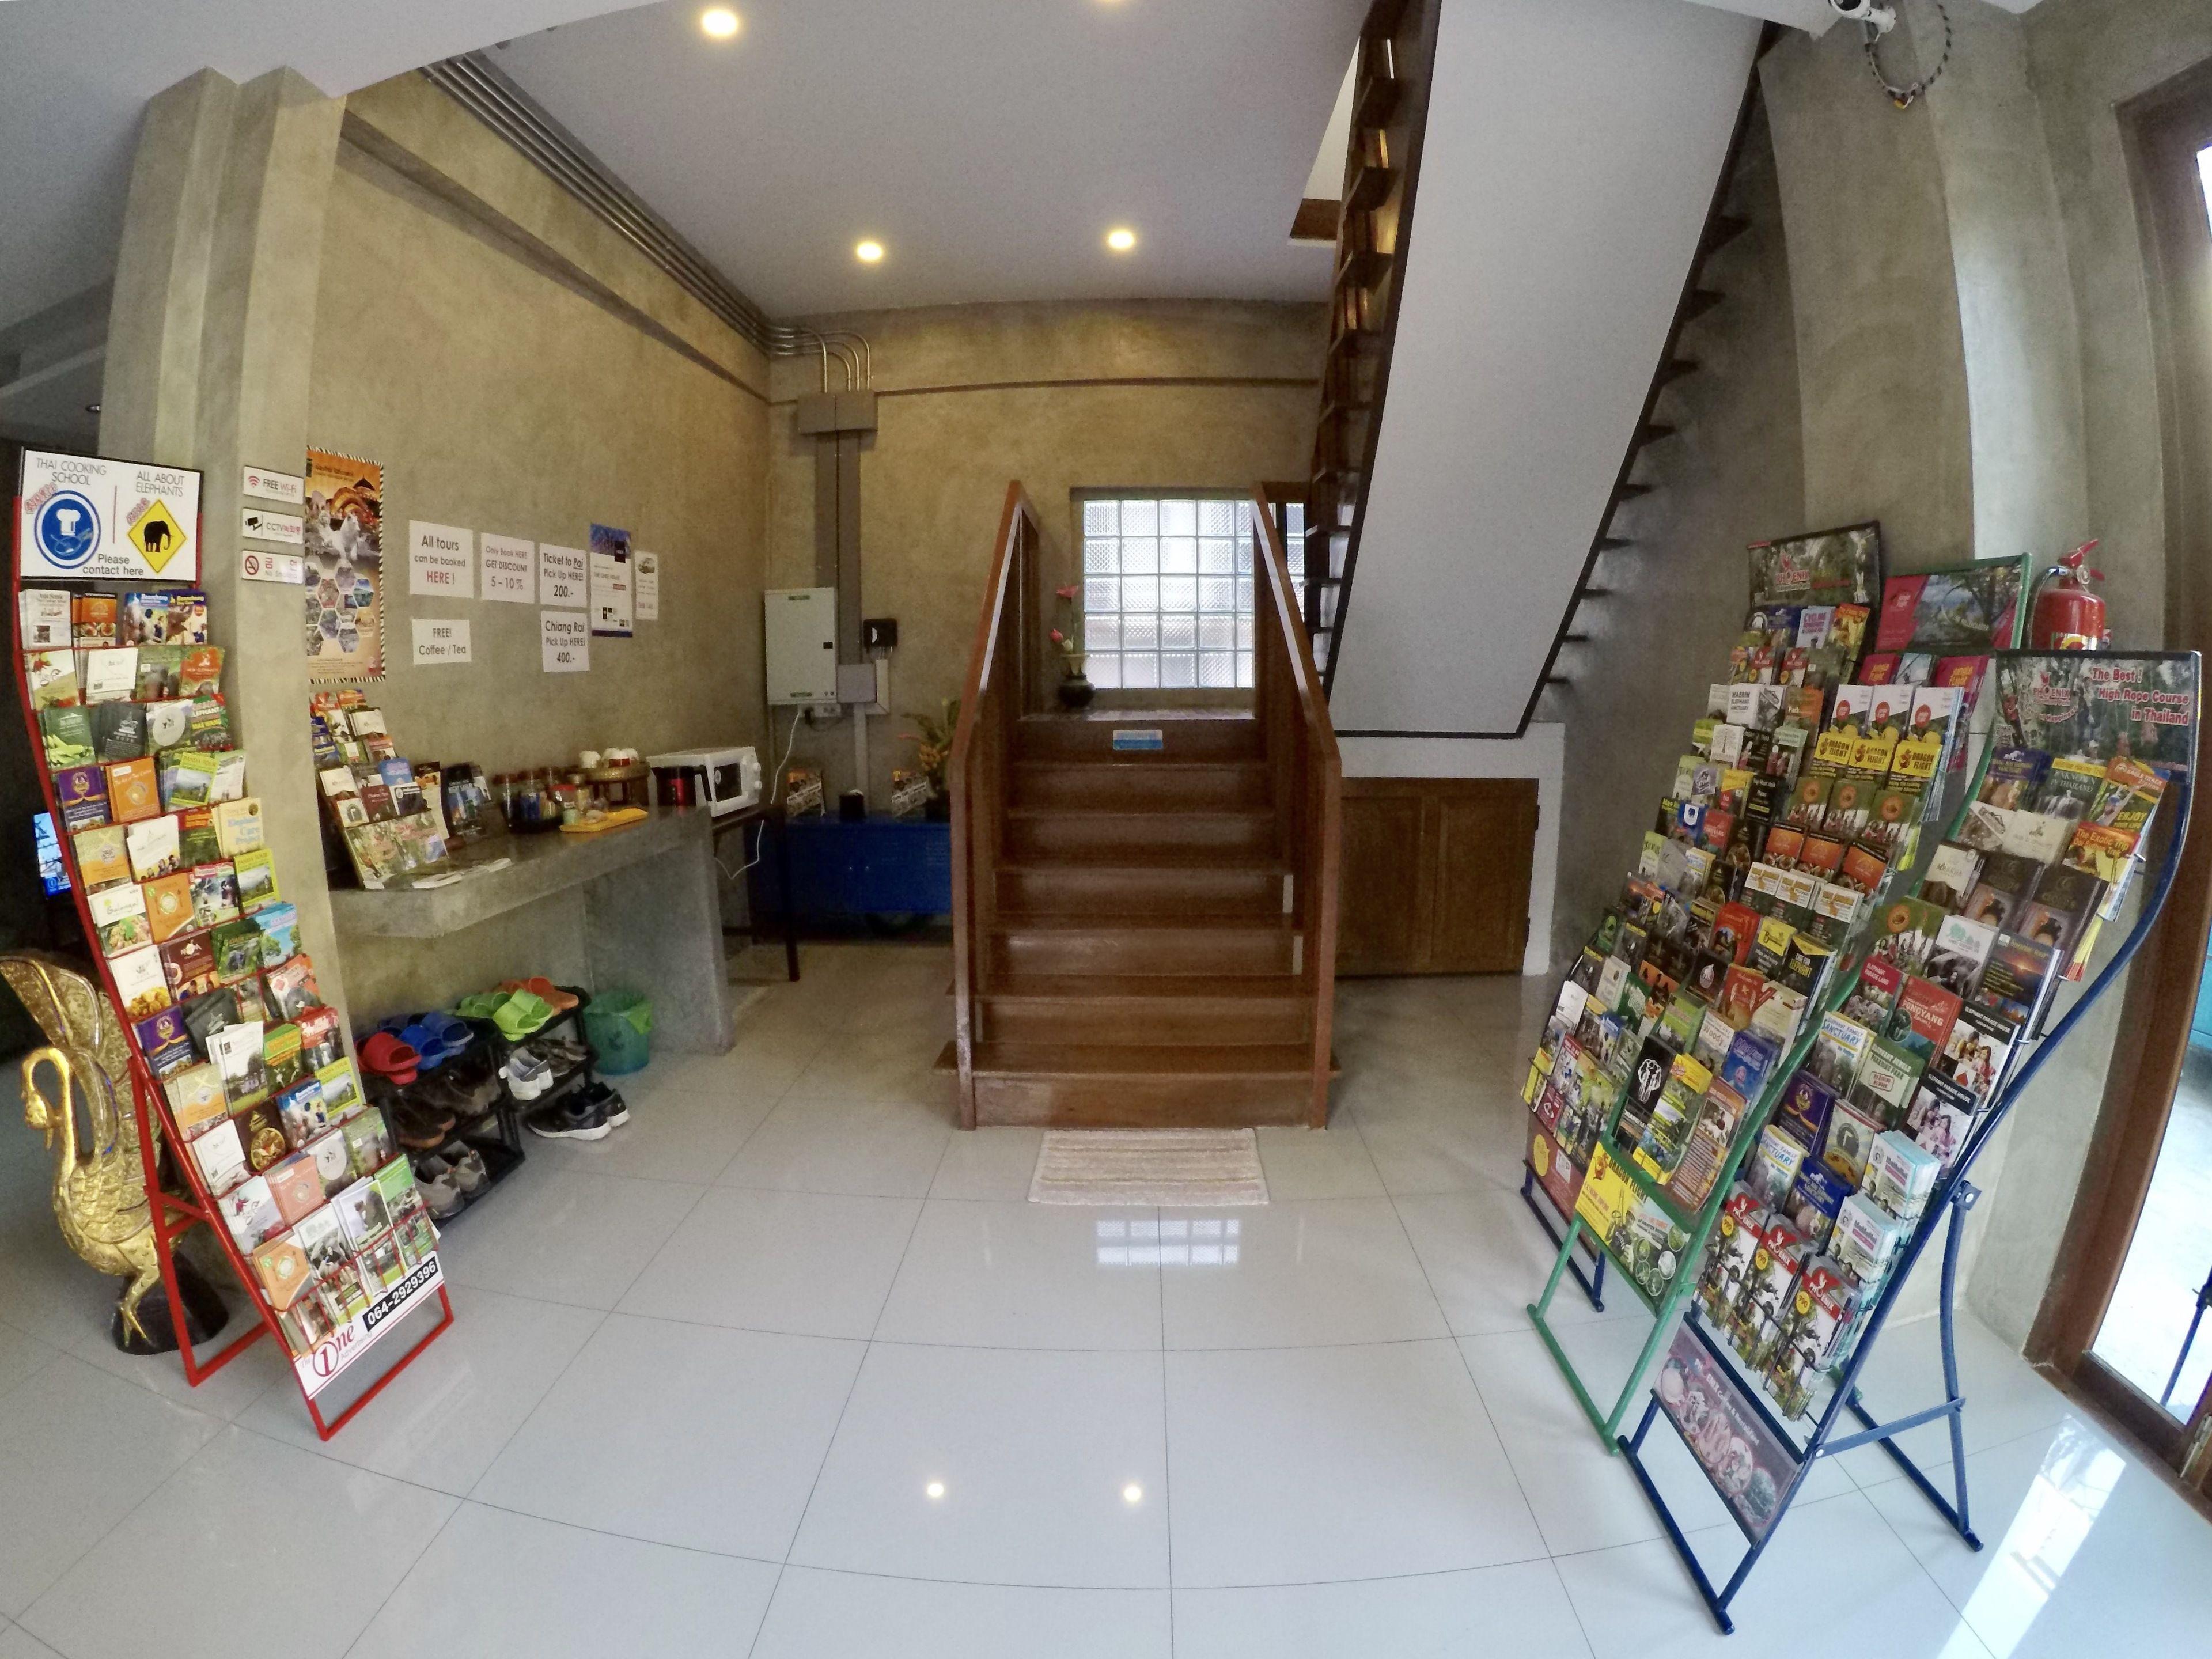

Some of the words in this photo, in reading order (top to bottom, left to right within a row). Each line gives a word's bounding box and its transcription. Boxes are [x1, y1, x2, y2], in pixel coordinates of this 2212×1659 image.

[36, 457, 57, 470] THAI
[60, 460, 107, 475] COOKING
[51, 471, 90, 486] SCHOOL
[137, 471, 151, 482] ALL
[155, 473, 184, 485] ABOUT
[263, 479, 279, 490] FREE
[135, 482, 184, 497] ELEPHANTS
[421, 535, 434, 547] All
[436, 536, 459, 551] tours
[98, 554, 130, 565] Please
[486, 546, 498, 556] Only
[501, 547, 514, 557] Book
[515, 548, 527, 559] HERE
[414, 555, 428, 563] can
[430, 556, 439, 565] be
[441, 557, 465, 567] booked
[486, 559, 497, 568] GET
[498, 561, 527, 572] DISCOUNT
[543, 552, 563, 565] Ticket
[565, 556, 572, 566] to
[573, 556, 584, 568] Pai
[82, 565, 120, 575] contact
[123, 566, 143, 575] here
[543, 569, 557, 577] Pick
[558, 570, 566, 579] Up
[491, 576, 496, 587] 5
[505, 578, 514, 589] 10
[433, 627, 452, 638] FREE!
[545, 620, 571, 634] Chiang
[573, 622, 585, 632] Rai
[546, 637, 558, 646] Pick
[559, 638, 568, 647] Up
[418, 645, 445, 656] Coffee
[453, 644, 466, 654] Tea
[2092, 668, 2110, 681] The
[2113, 669, 2136, 683] Best
[2033, 685, 2071, 699] PHOENIX
[2098, 688, 2120, 702] High
[2123, 690, 2148, 704] Rope
[2152, 692, 2190, 705] Course
[2131, 708, 2141, 722] in
[2145, 709, 2190, 725] Thailand
[1911, 752, 1934, 762] DRAGON
[2059, 780, 2093, 793] THAILAND
[2117, 812, 2147, 821] ENJOY
[2076, 828, 2089, 839] The
[2090, 832, 2113, 846] Exotic
[1821, 1018, 1861, 1046] SANCTUARY
[1733, 1206, 1755, 1231] PHOENIX
[1767, 1239, 1791, 1266] PHOENIX
[367, 1260, 436, 1325] 064-2929396
[1809, 1281, 1835, 1311] PHOENIX
